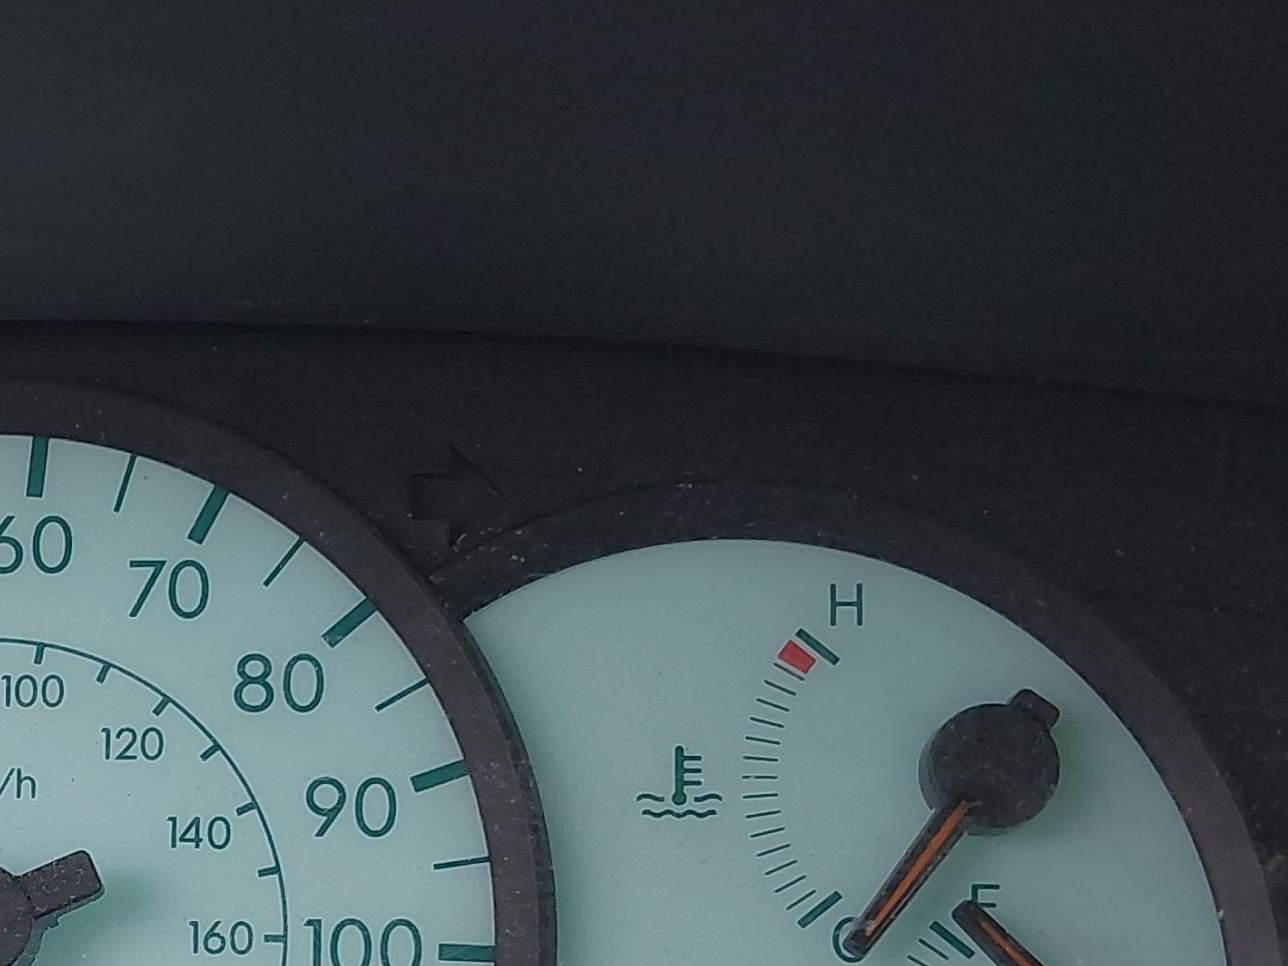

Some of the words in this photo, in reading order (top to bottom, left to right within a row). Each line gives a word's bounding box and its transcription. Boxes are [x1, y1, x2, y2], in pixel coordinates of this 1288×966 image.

[129, 560, 209, 619] 70
[830, 583, 862, 626] H
[2, 675, 64, 707] 100
[234, 654, 324, 713] 80
[101, 727, 164, 760] 120
[306, 777, 396, 837] 90
[167, 816, 231, 849] 140
[189, 921, 253, 955] 160
